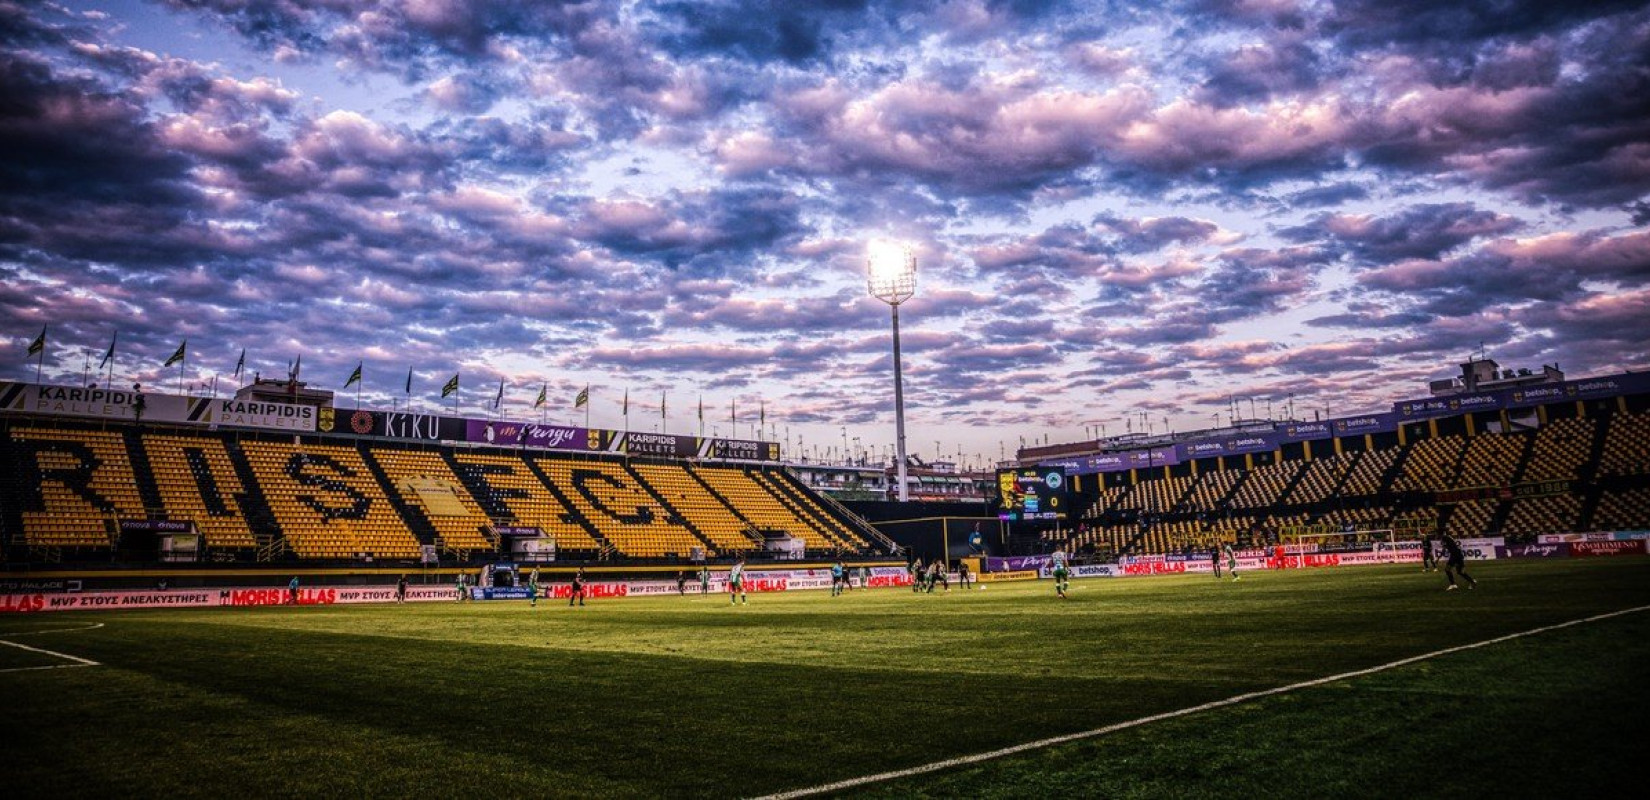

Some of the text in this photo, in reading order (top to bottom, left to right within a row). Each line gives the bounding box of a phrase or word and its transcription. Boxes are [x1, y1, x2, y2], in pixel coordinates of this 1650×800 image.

[38, 387, 145, 406] KARIPIDIS
[222, 401, 312, 418] KARIPIDIS
[222, 414, 311, 429] PALLETS
[517, 423, 575, 447] Pengu
[629, 433, 676, 445] KARIPIDIS
[629, 443, 676, 453] PALLETS
[1378, 542, 1424, 551] Panason
[1267, 557, 1298, 568] MRIS
[554, 584, 628, 598] MOS HELLAS
[729, 578, 787, 592] MRIS HELLAS
[51, 593, 208, 607] MVP ΣΤΟΥΣ ΑΝΕΛΚΥΣΤΗΡΕΣ
[232, 589, 281, 605] MORIS
[340, 590, 458, 600] MVP ΣΤΟΥΣ ΑΕΛΚΥΣΤΗΡΕΣ
